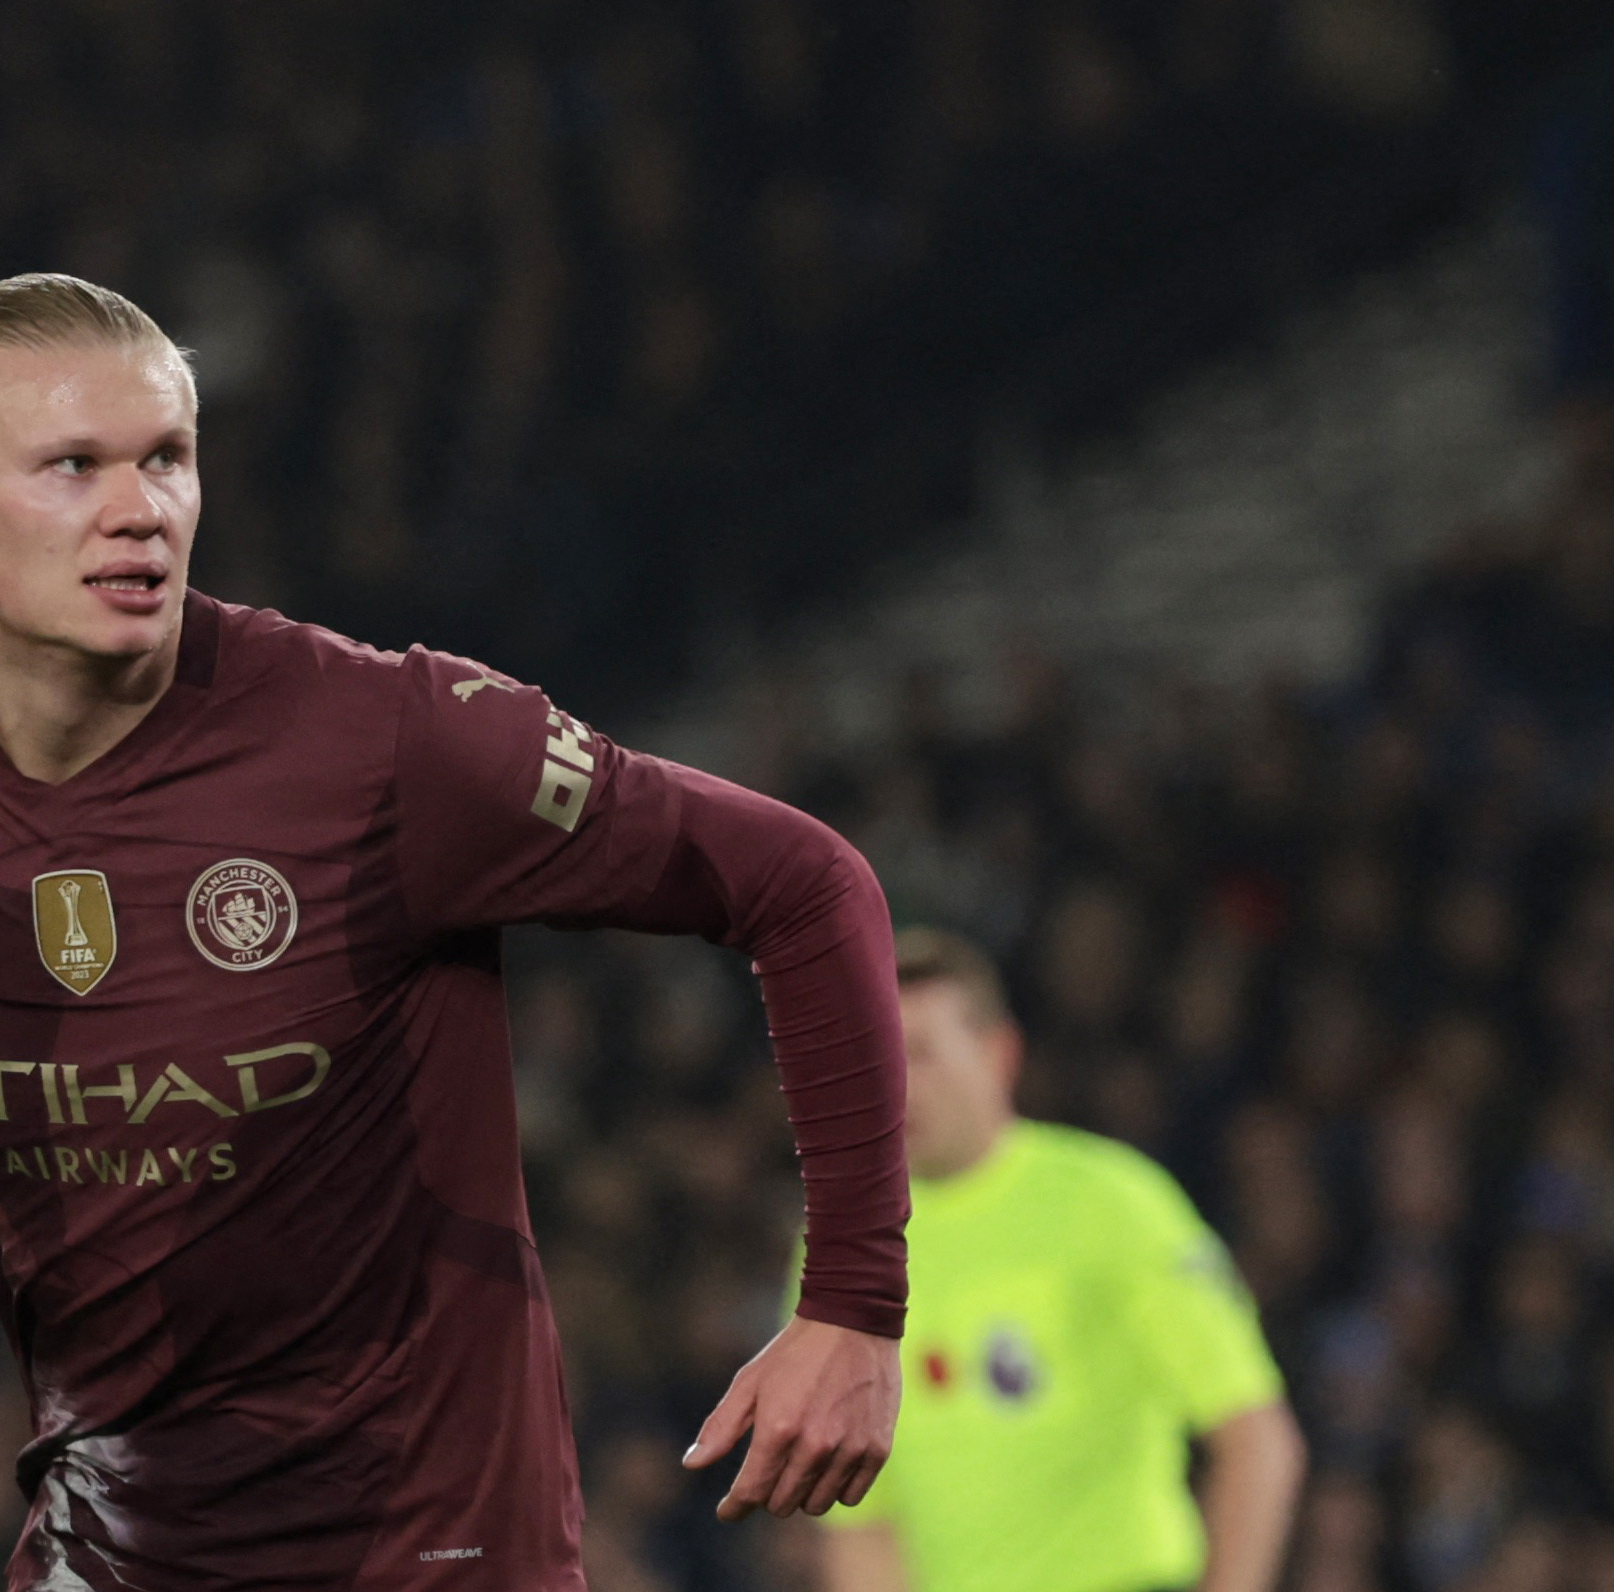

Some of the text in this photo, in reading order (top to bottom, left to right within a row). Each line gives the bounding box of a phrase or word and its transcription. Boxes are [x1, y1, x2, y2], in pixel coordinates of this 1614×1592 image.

[196, 867, 282, 906] MANCHESTER
[60, 948, 96, 964] FIFA
[231, 949, 263, 963] CITY
[6, 1142, 237, 1187] AIRWAYS
[419, 1547, 483, 1562] ULTRAWEAVE
